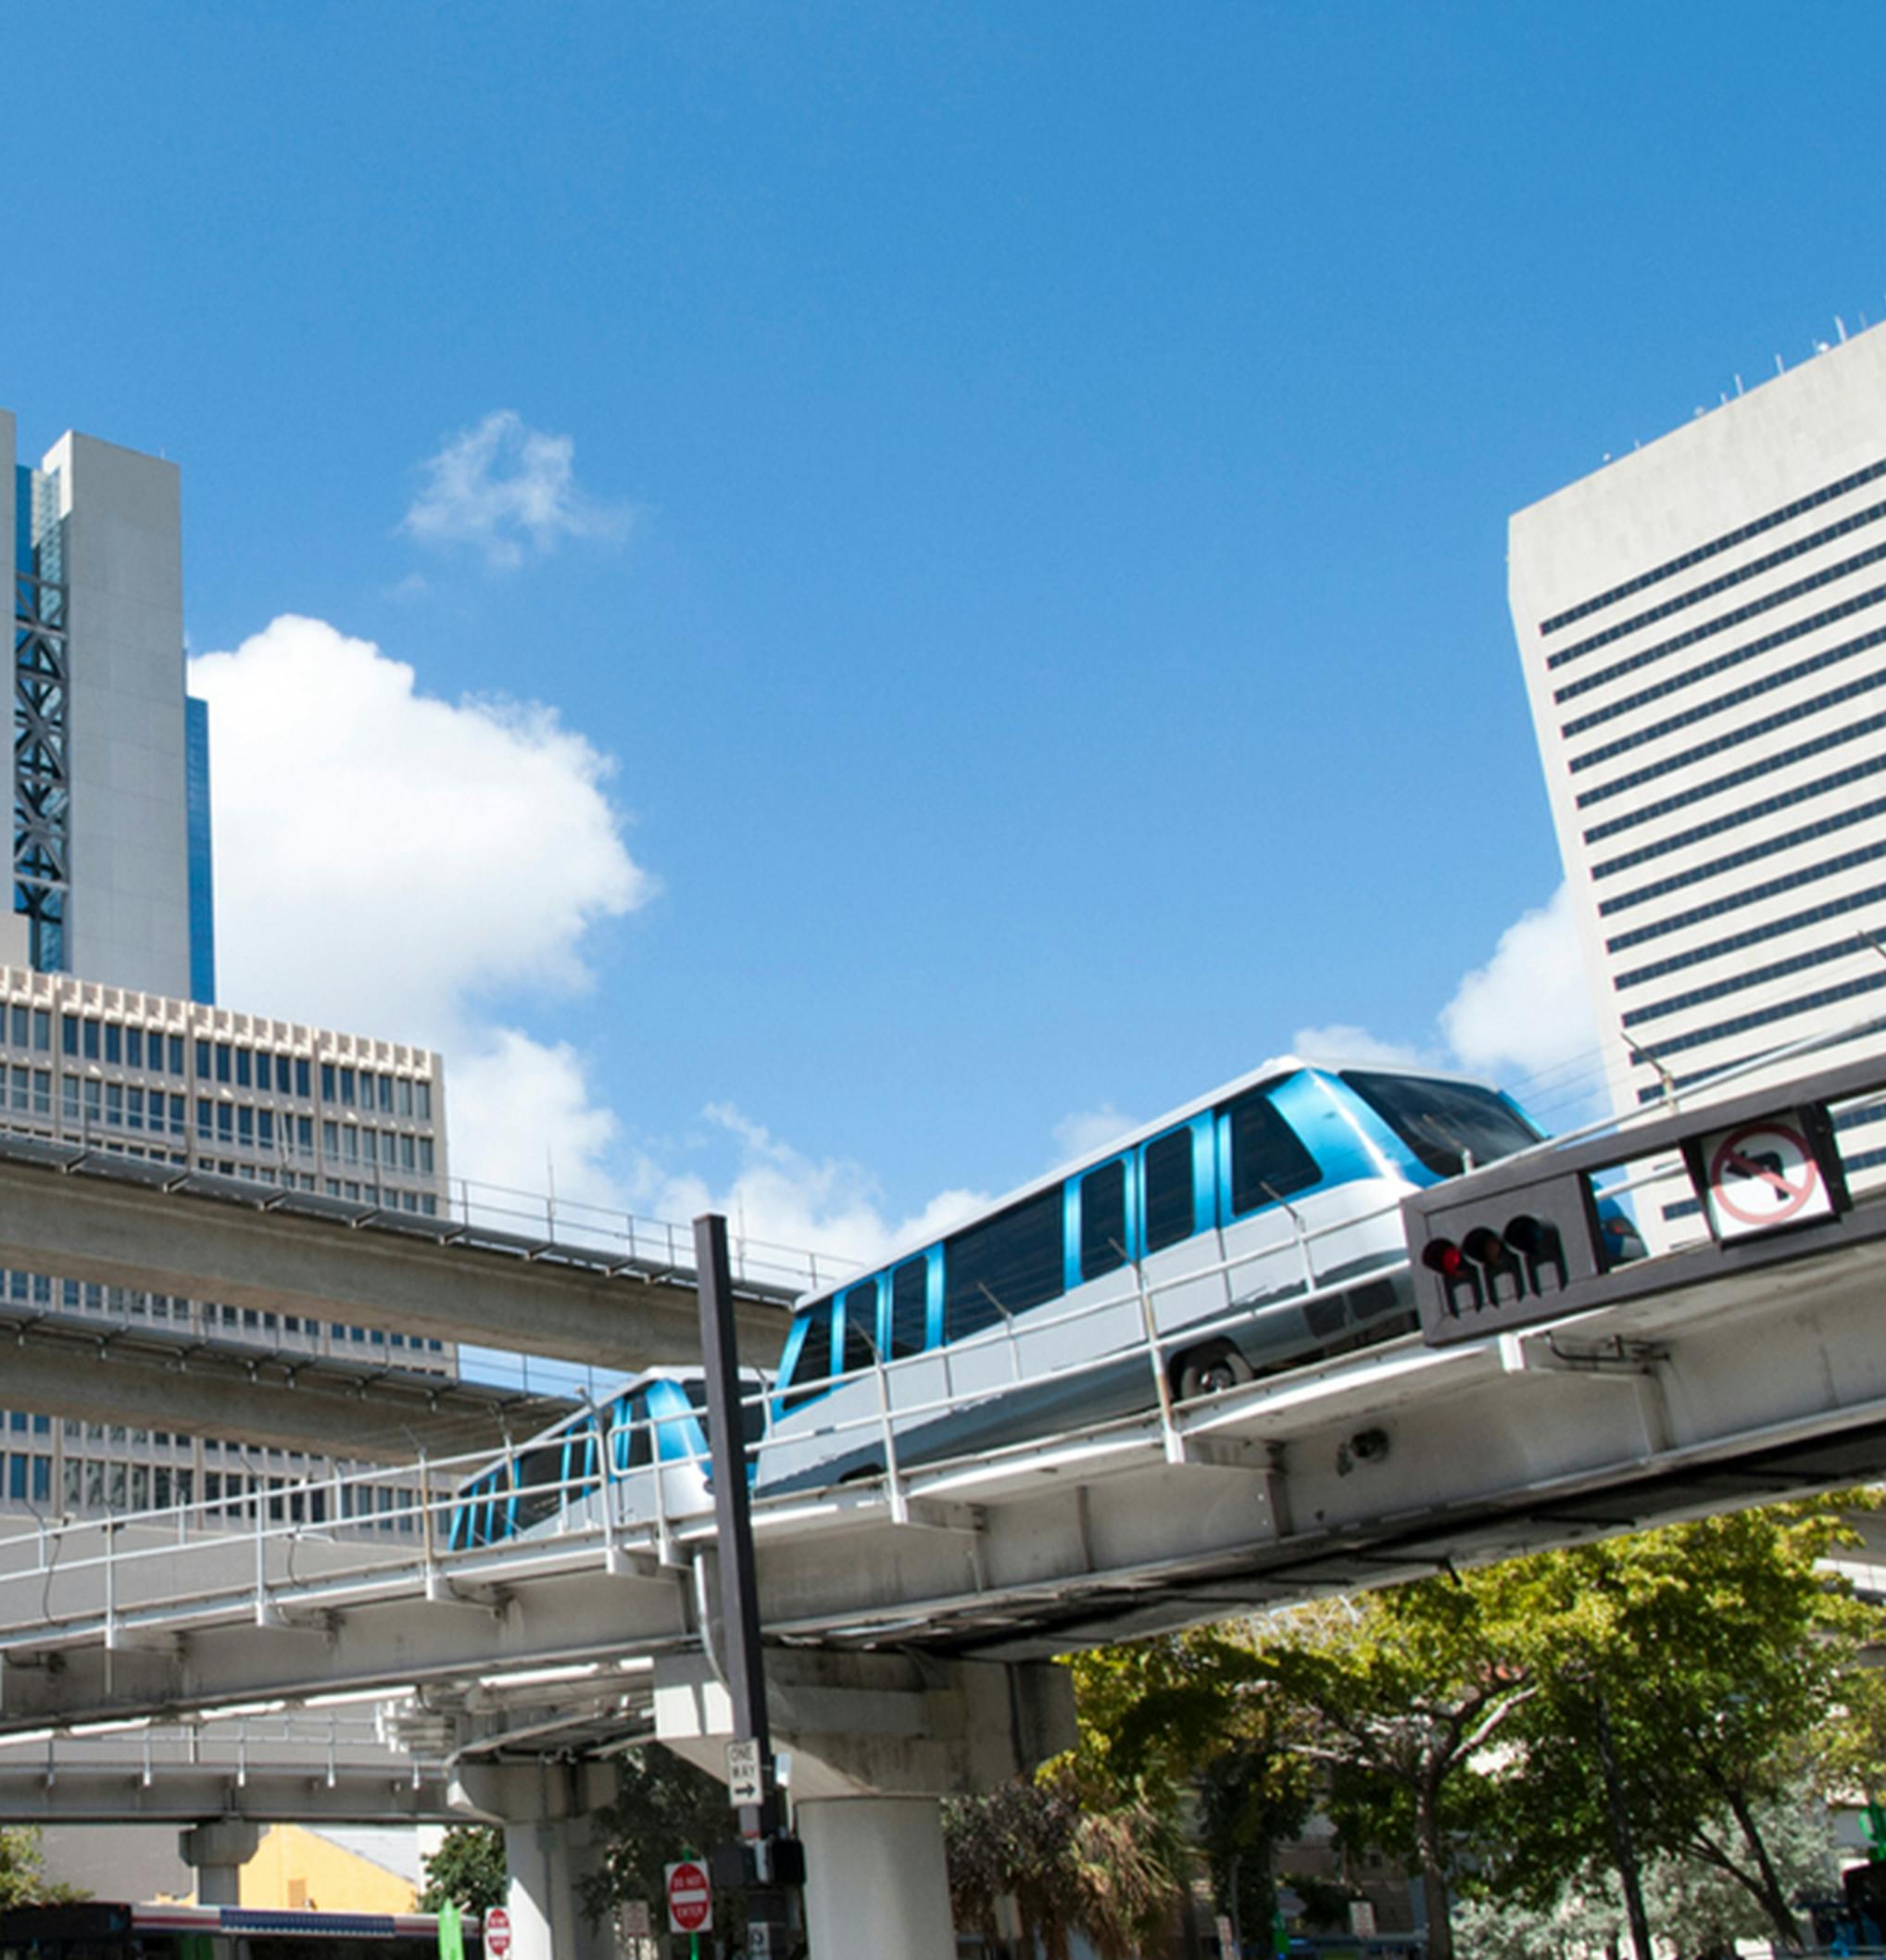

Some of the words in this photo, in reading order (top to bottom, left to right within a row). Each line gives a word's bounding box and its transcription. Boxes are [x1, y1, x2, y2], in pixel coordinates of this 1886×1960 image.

[731, 1744, 754, 1763] ONE
[733, 1765, 755, 1778] WAY
[686, 1876, 701, 1886] NOT
[676, 1905, 703, 1917] ENTER
